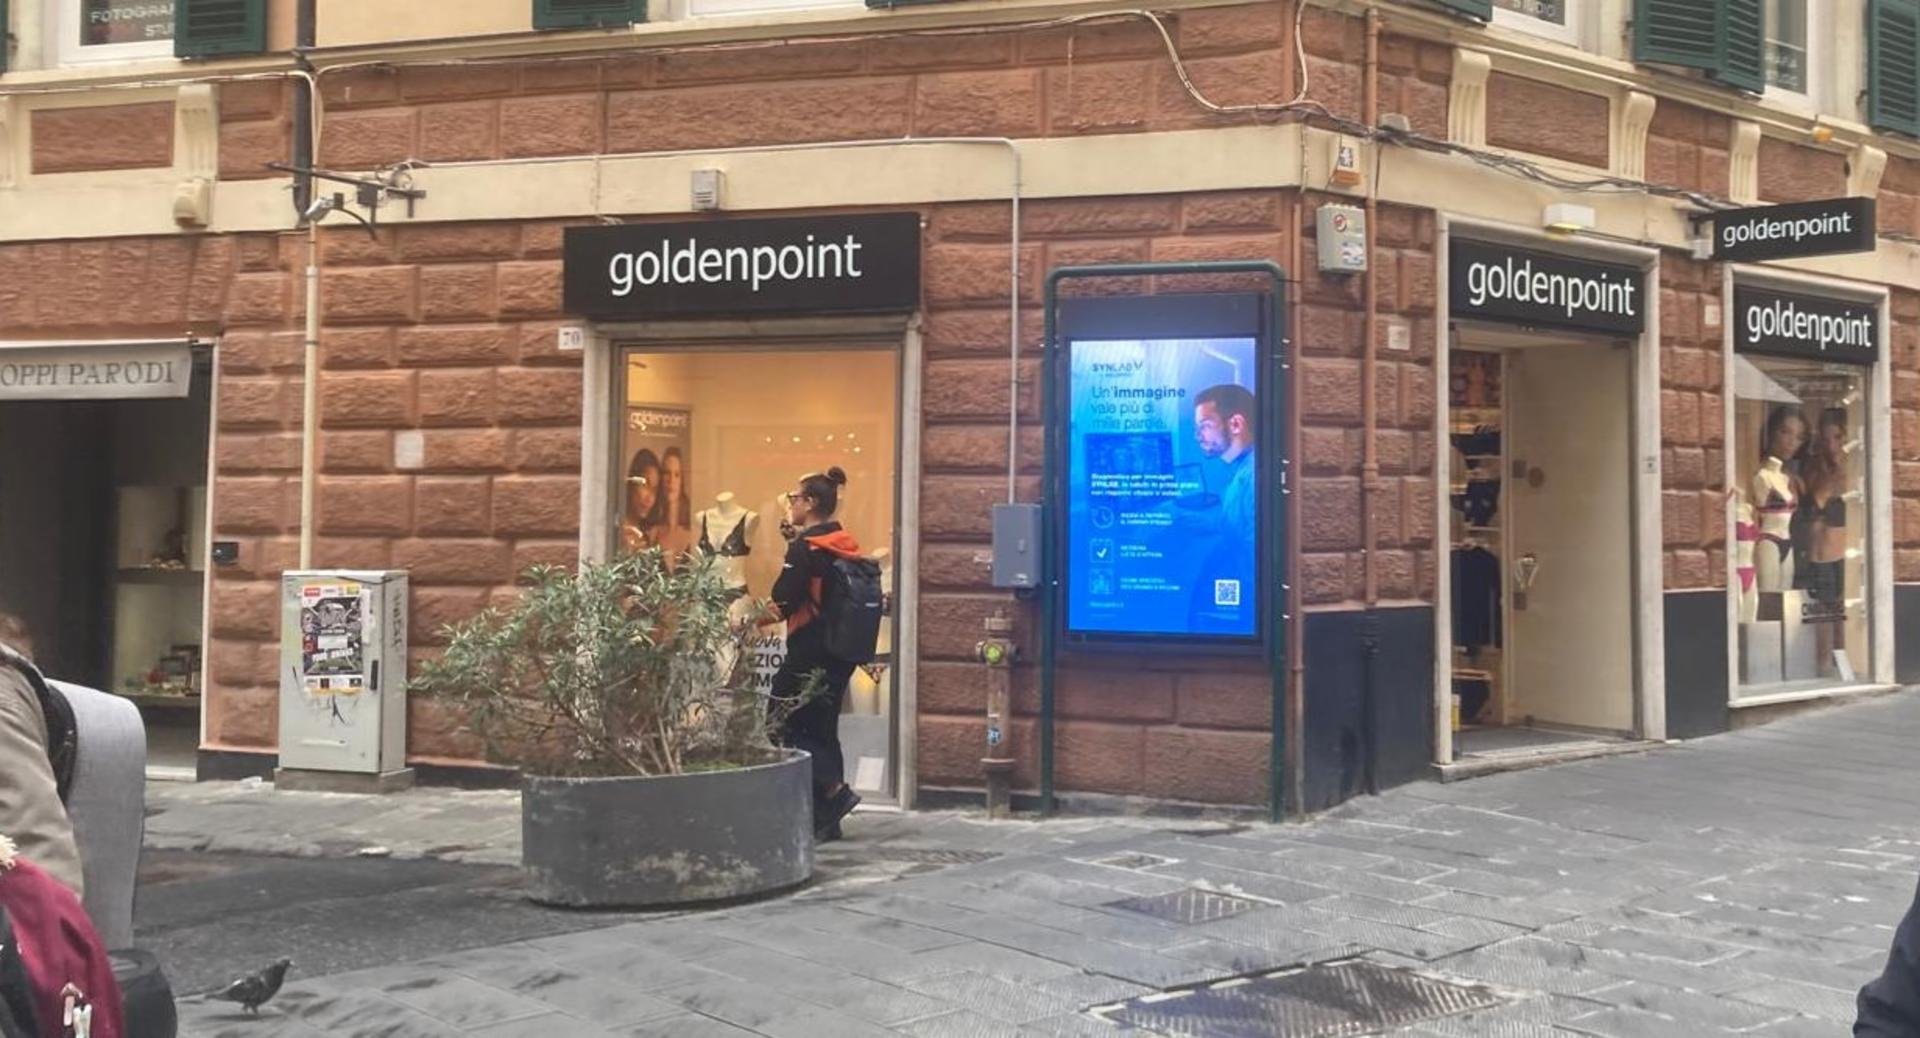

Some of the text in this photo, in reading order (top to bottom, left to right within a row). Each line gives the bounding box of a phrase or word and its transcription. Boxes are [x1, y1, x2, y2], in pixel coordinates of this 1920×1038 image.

[1723, 212, 1852, 248] goldenpoint
[609, 235, 862, 296] goldenpoint
[1468, 257, 1635, 318] goldenpoint
[1747, 300, 1872, 350] goldenpoint
[69, 361, 176, 385] PARODI
